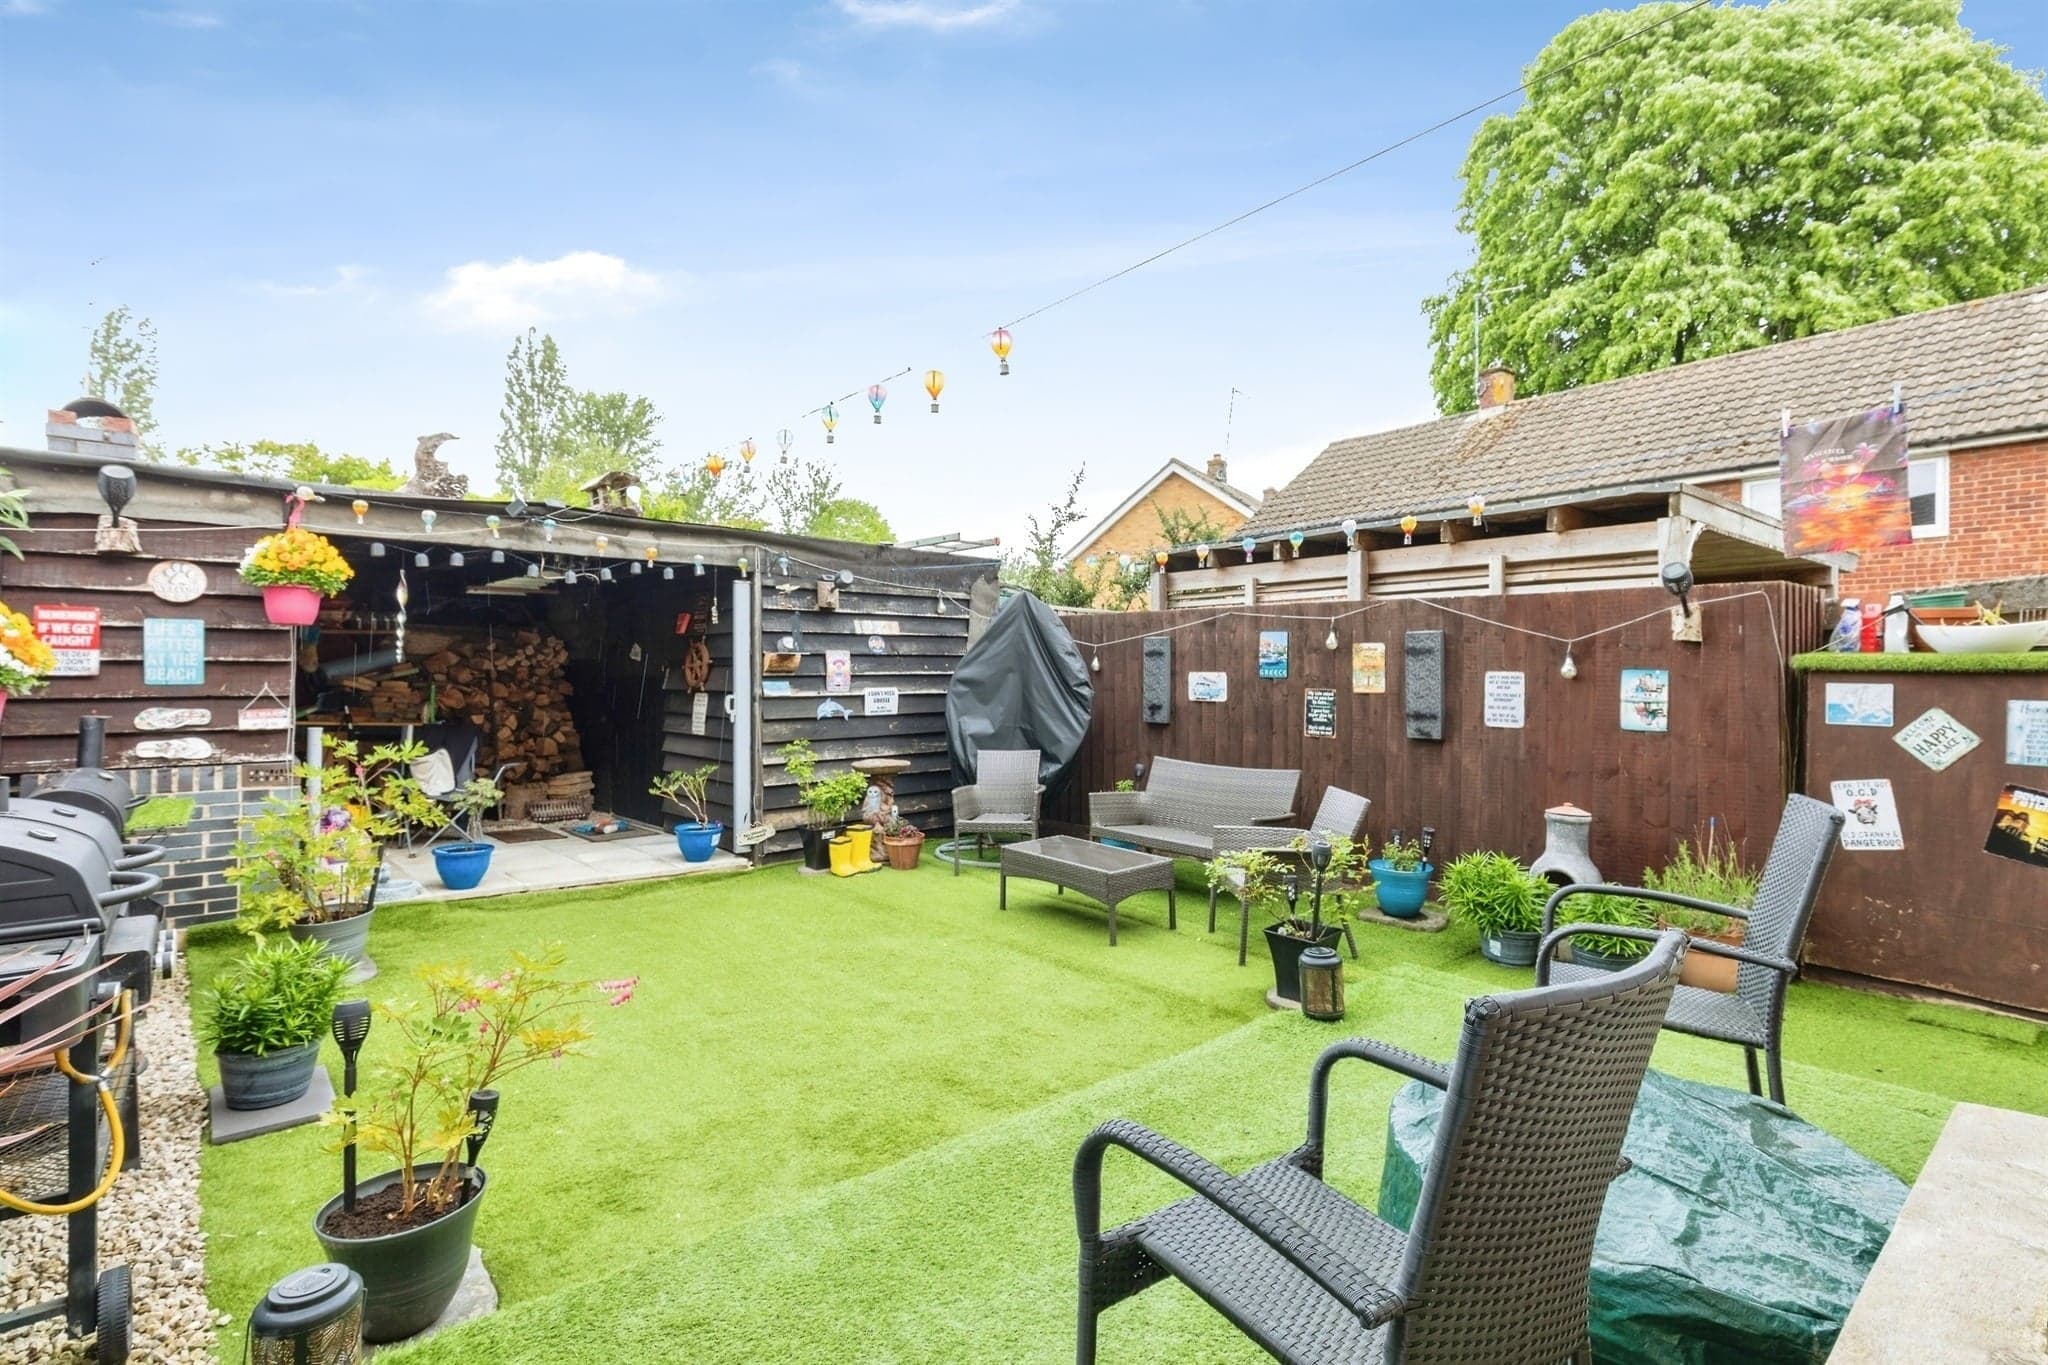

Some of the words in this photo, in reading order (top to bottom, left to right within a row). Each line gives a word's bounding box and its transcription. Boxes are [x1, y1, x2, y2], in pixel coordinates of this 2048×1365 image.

[37, 621, 51, 634] IF
[52, 622, 71, 635] WE
[72, 622, 95, 635] GET
[147, 623, 178, 636] LIFE
[182, 624, 197, 637] IS
[40, 634, 93, 647] CAUGHT
[147, 653, 167, 666] AT
[172, 654, 199, 667] THE
[147, 667, 197, 681] BEACH
[1259, 669, 1287, 678] GREECE
[1912, 721, 1957, 756] HAPPY
[1933, 737, 1960, 757] PLACE
[1843, 839, 1902, 847] DANGEROUS
